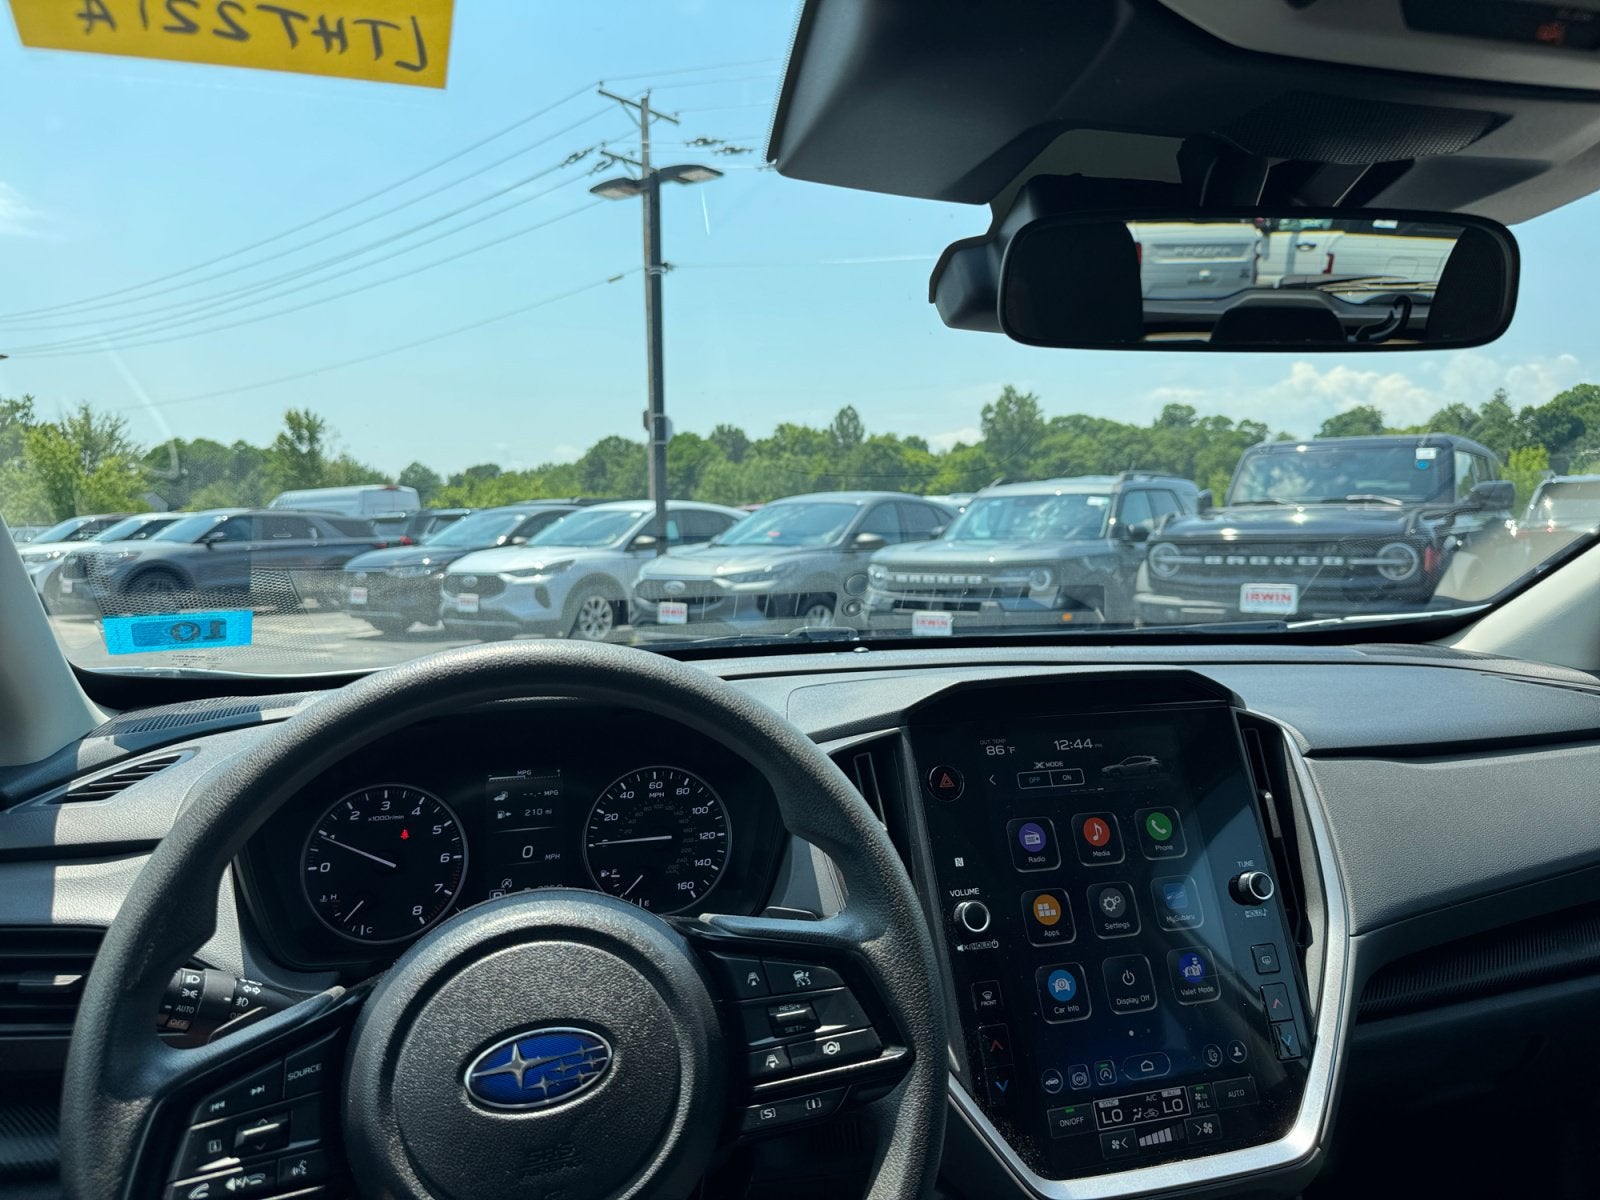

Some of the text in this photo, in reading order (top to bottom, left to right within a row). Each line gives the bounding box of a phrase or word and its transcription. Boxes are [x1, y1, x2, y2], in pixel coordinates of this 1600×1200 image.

[1204, 555, 1345, 566] BRONCO
[1053, 738, 1093, 751] 12:44
[986, 745, 1005, 756] 86
[620, 791, 635, 799] 40
[381, 801, 390, 811] 3
[692, 806, 709, 815] 100
[350, 811, 360, 821] 2
[411, 807, 421, 816] 4
[525, 808, 543, 816] 210
[604, 813, 618, 821] 20
[432, 825, 442, 835] 5
[699, 832, 715, 840] 120
[522, 845, 533, 858] 0
[1092, 849, 1111, 857] Media
[440, 853, 450, 863] 6
[695, 858, 711, 867] 140
[1028, 856, 1046, 864] Radio
[320, 862, 331, 872] 0
[434, 884, 443, 893] 7
[677, 882, 694, 890] 160
[949, 888, 980, 897] VOLUME
[412, 905, 422, 915] 8
[1104, 922, 1131, 931] Settings
[1043, 930, 1060, 938] Apps
[1180, 986, 1214, 997] Valet Mode
[1116, 997, 1139, 1006] Display
[176, 1005, 195, 1014] AUTO
[1054, 1006, 1066, 1014] Car
[287, 1063, 323, 1082] SOURCE
[1227, 1089, 1245, 1098] AUTO
[1162, 1098, 1184, 1114] LO
[1101, 1108, 1124, 1124] LO
[1059, 1116, 1085, 1128] ON/OFF
